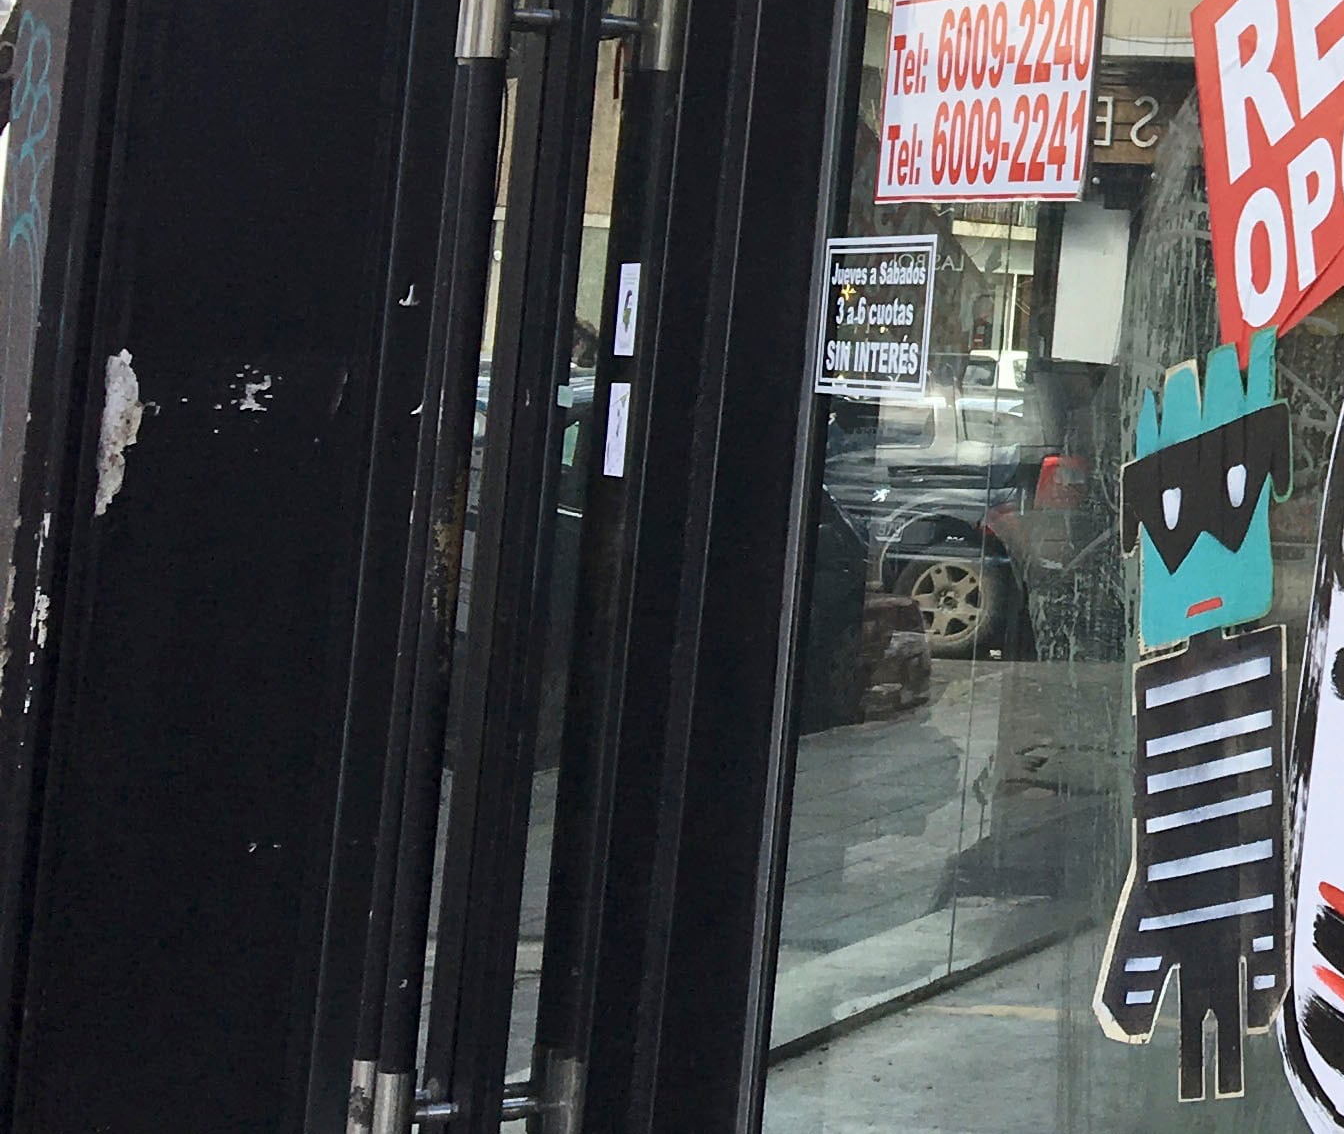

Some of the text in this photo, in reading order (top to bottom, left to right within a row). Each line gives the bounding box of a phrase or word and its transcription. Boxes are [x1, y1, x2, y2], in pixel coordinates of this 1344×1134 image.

[893, 33, 929, 95] Tel:
[887, 90, 1087, 186] Tel: 6009-2241
[831, 261, 926, 285] Jueves a Sábados
[836, 298, 844, 325] 3
[857, 296, 866, 325] 6
[868, 297, 914, 326] cuotas
[825, 335, 919, 375] SIN INTERÉS
